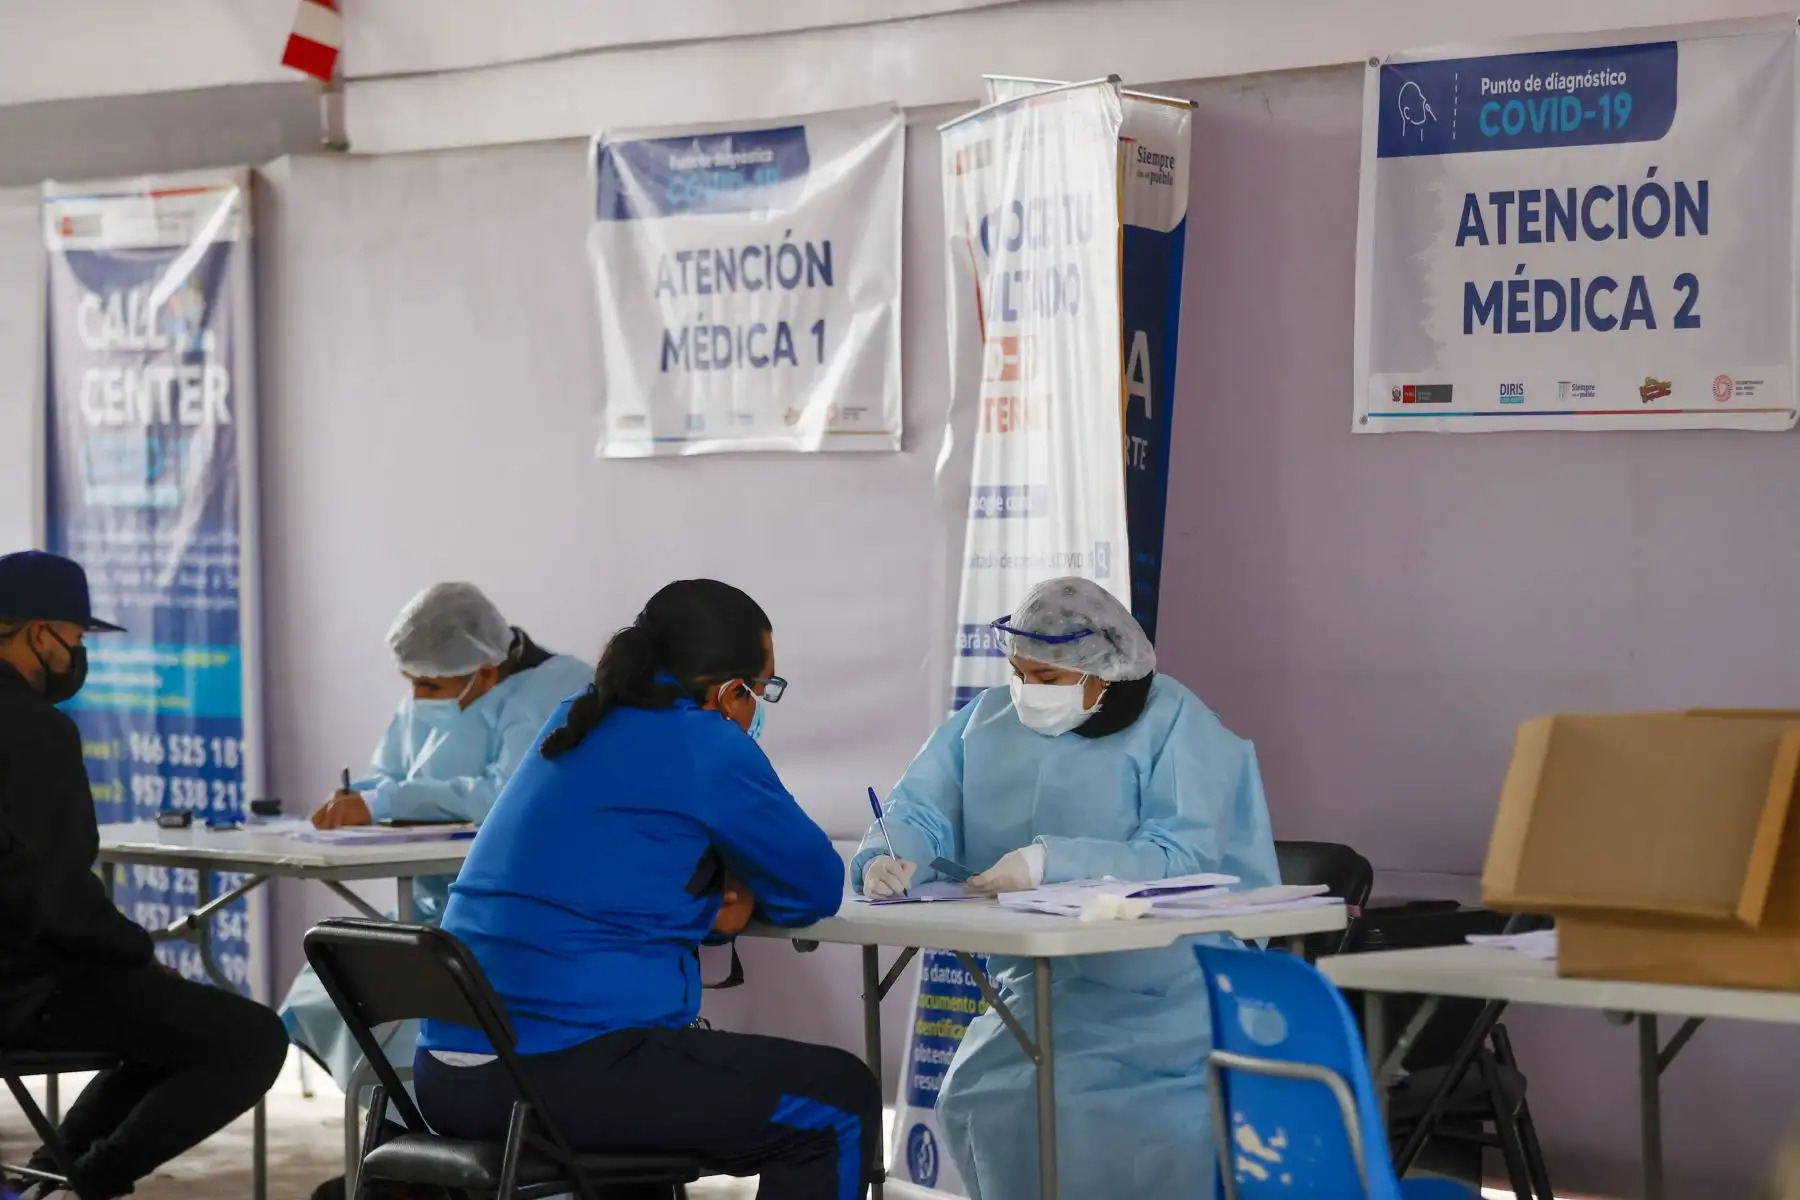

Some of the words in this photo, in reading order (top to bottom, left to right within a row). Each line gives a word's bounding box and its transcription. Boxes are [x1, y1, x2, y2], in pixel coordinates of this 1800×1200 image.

[1481, 77, 1521, 95] Punto
[1524, 74, 1541, 92] de
[1545, 68, 1626, 93] diagnóstico
[1480, 91, 1633, 137] COVID-19
[1136, 146, 1175, 172] Siempre
[1455, 166, 1709, 247] ATENCIÓN
[655, 229, 834, 299] ATENCIÓN
[78, 287, 169, 352] CALL
[1463, 264, 1657, 335] MÉDICA
[1673, 272, 1701, 329] 2
[661, 312, 798, 373] MÉDICA
[811, 319, 826, 365] 1
[79, 362, 233, 426] CENTER
[1500, 383, 1524, 396] DIRIS
[1571, 383, 1596, 394] Siempre
